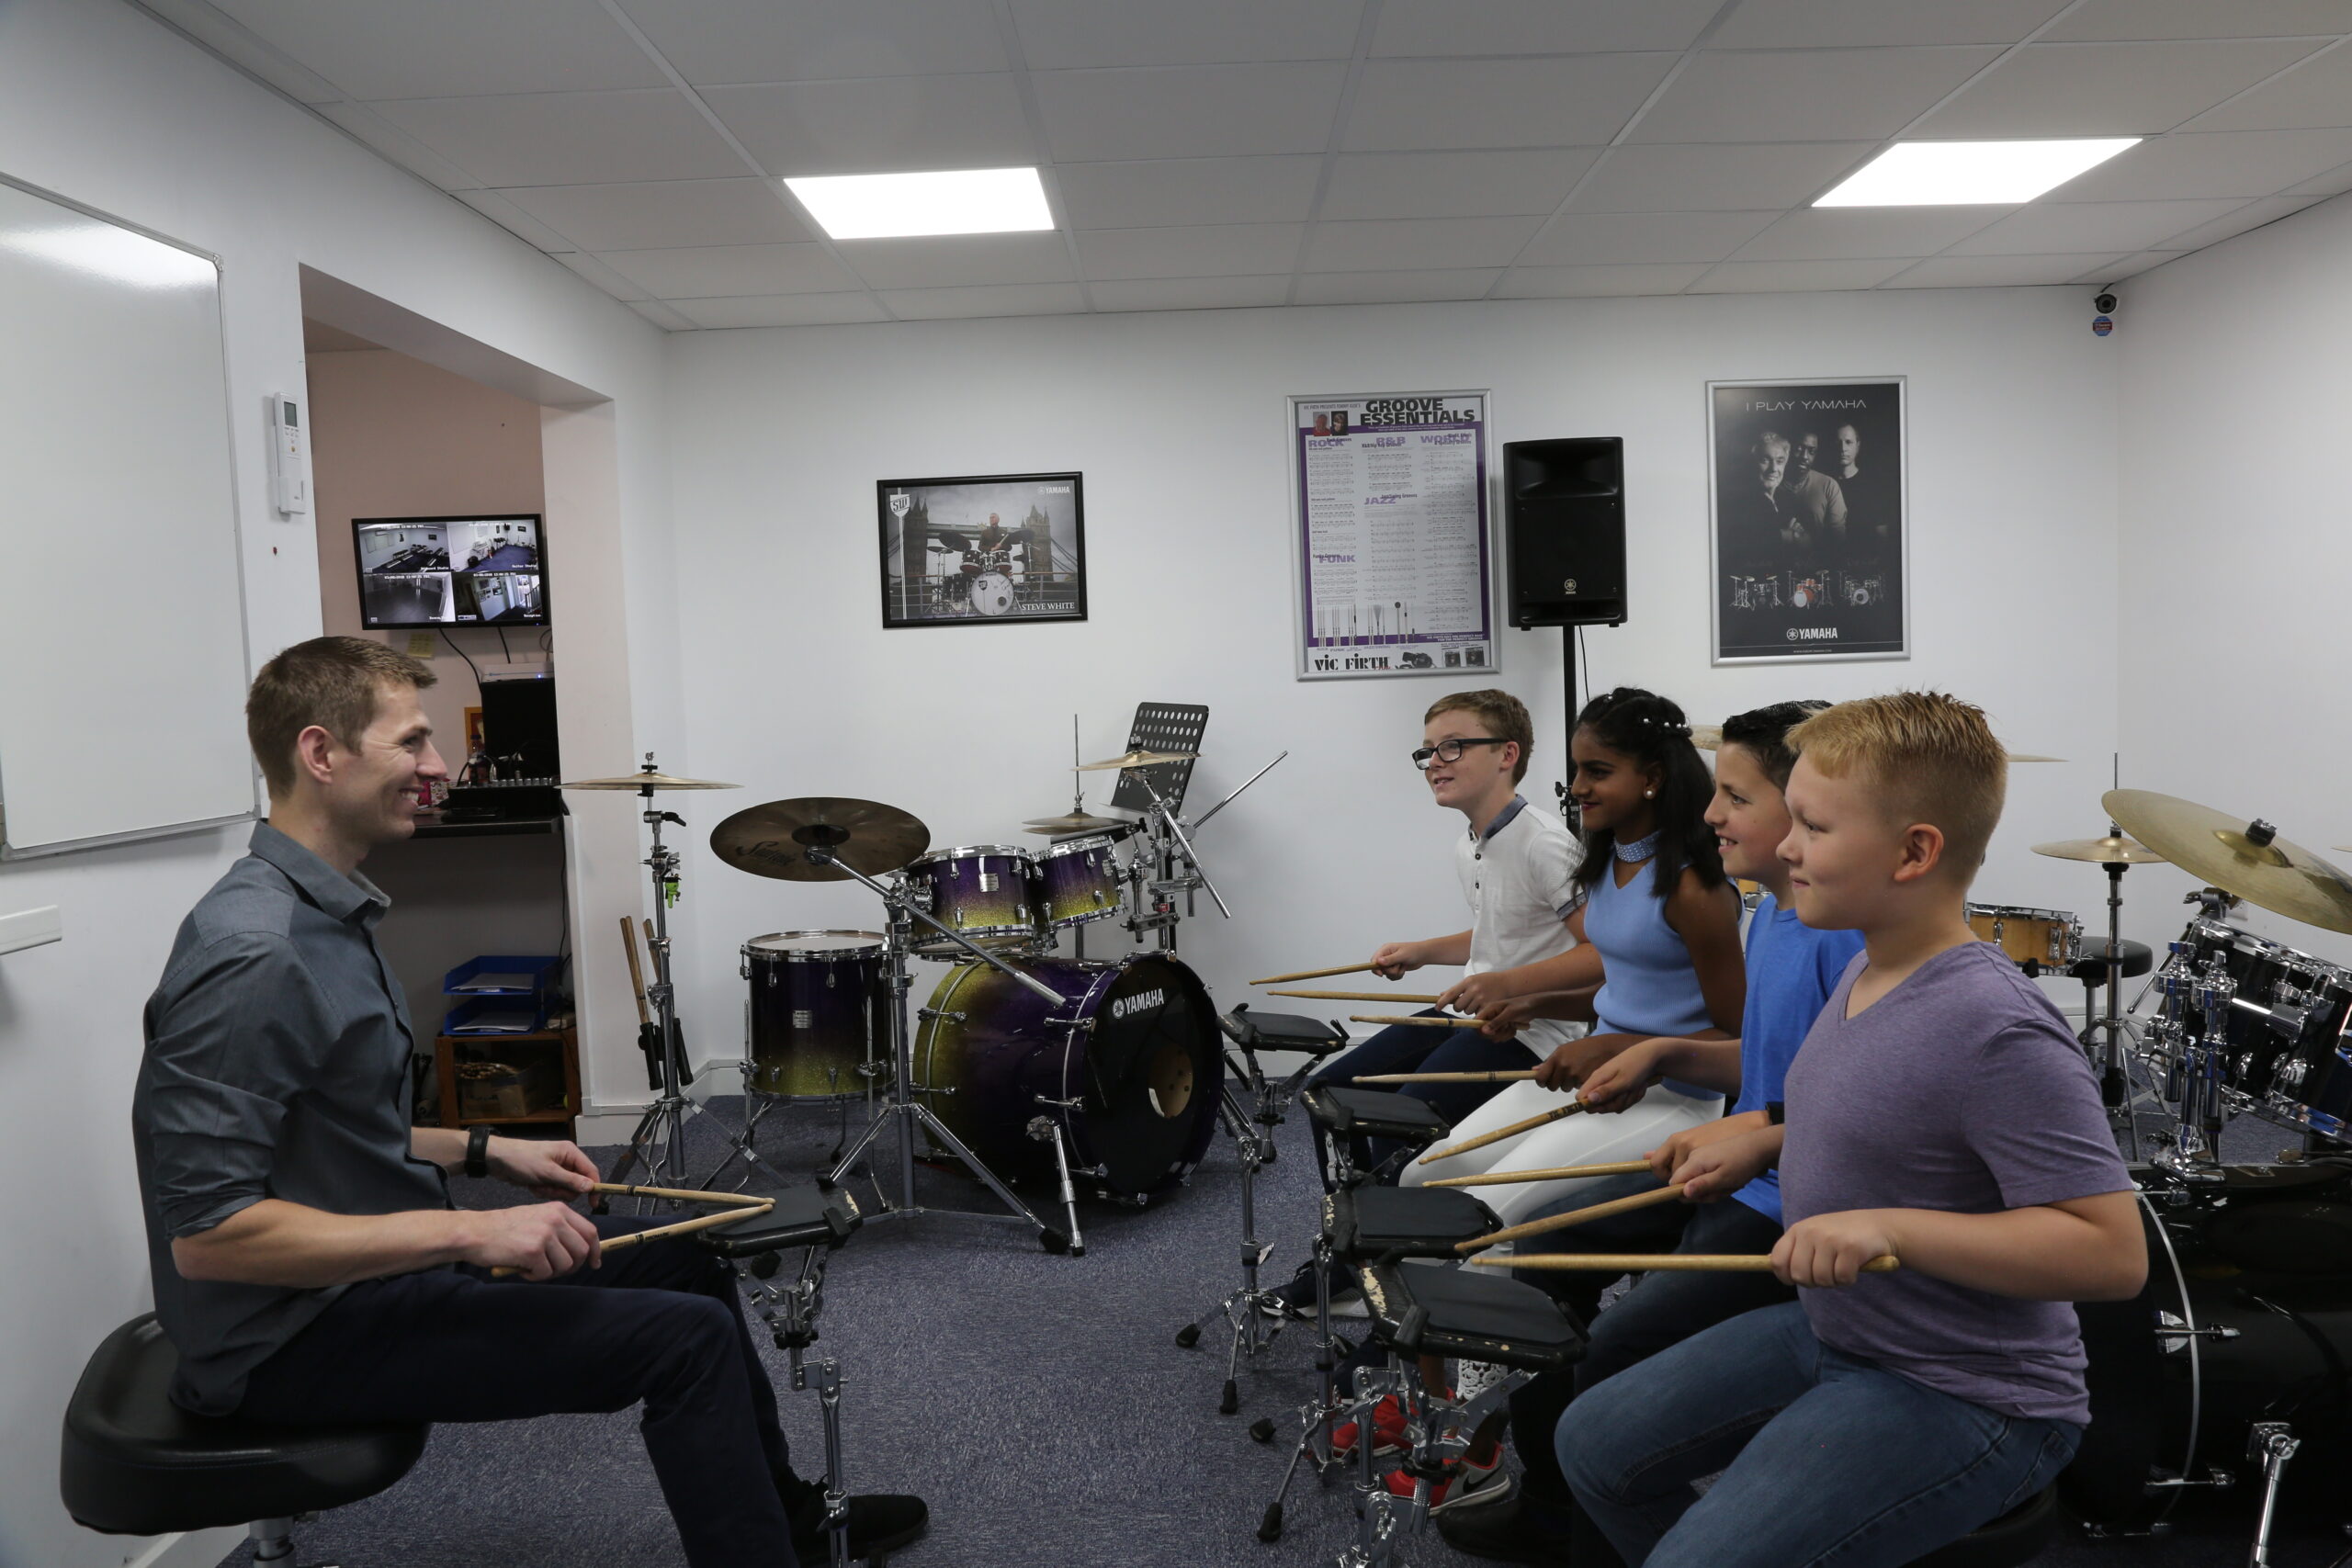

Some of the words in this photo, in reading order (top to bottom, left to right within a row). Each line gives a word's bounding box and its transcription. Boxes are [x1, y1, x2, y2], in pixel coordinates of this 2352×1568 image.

[1365, 399, 1443, 413] GROOVE
[1756, 401, 1795, 412] PLAY
[1801, 400, 1866, 411] YAMAHA
[1361, 410, 1476, 426] ESSENTIALS
[1376, 436, 1406, 446] R&B
[1046, 486, 1070, 494] YAMAHA
[1363, 497, 1396, 505] JAZZ
[1319, 555, 1356, 564] FUNK
[1022, 603, 1046, 611] STEVE
[1047, 602, 1075, 610] WHITE
[1799, 627, 1838, 639] YAMAHA
[1125, 988, 1164, 1015] YAMAHA
